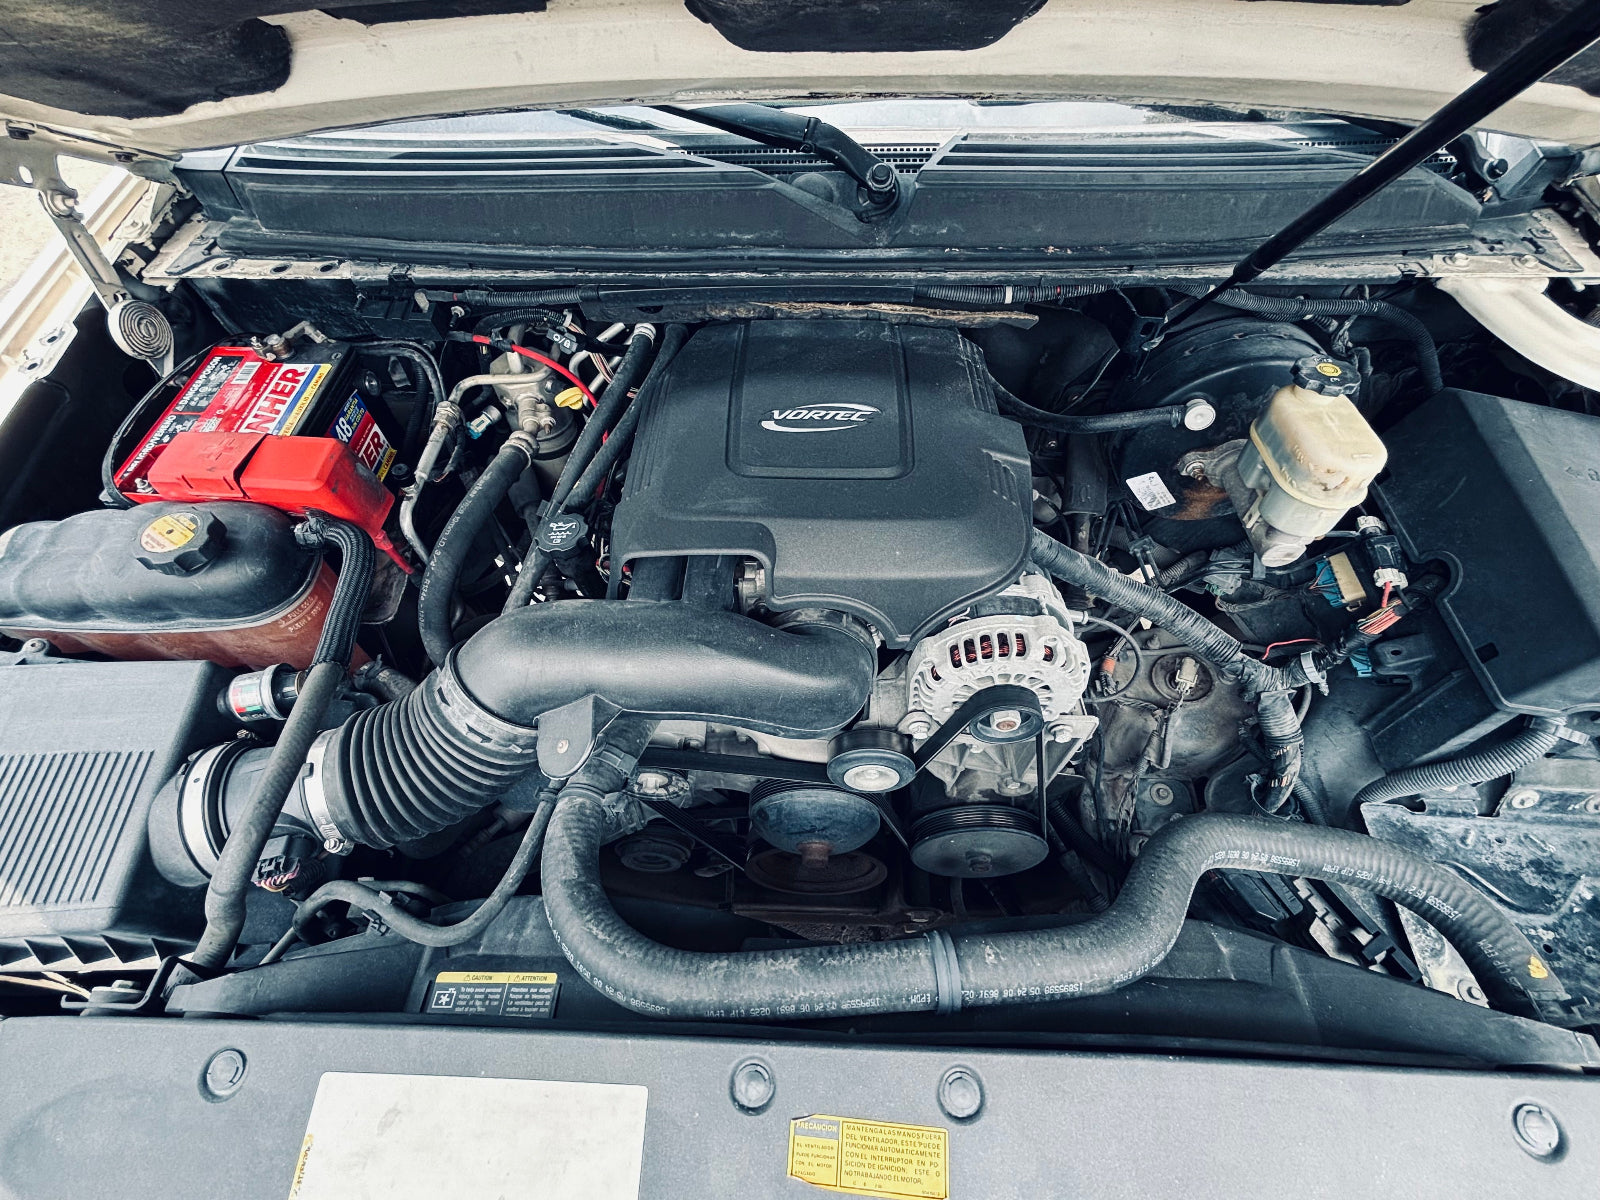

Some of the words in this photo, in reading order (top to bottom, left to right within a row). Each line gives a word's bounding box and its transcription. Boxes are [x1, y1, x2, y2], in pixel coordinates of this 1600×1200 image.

[245, 366, 307, 434] NHER
[772, 410, 874, 421] VORTEC
[335, 417, 352, 444] 48
[1017, 986, 1029, 997] 24
[1029, 984, 1042, 997] 05
[1045, 982, 1084, 995] 15895598
[796, 1121, 838, 1133] PRECAUCION
[846, 1125, 882, 1134] MANTENGA
[896, 1131, 920, 1139] MANOS
[845, 1142, 879, 1152] FUNCIONAR
[879, 1146, 941, 1159] AUTOMATICAMENTE
[870, 1155, 914, 1165] INTERRUPTOR
[853, 1170, 892, 1181] TRABAJANDO
